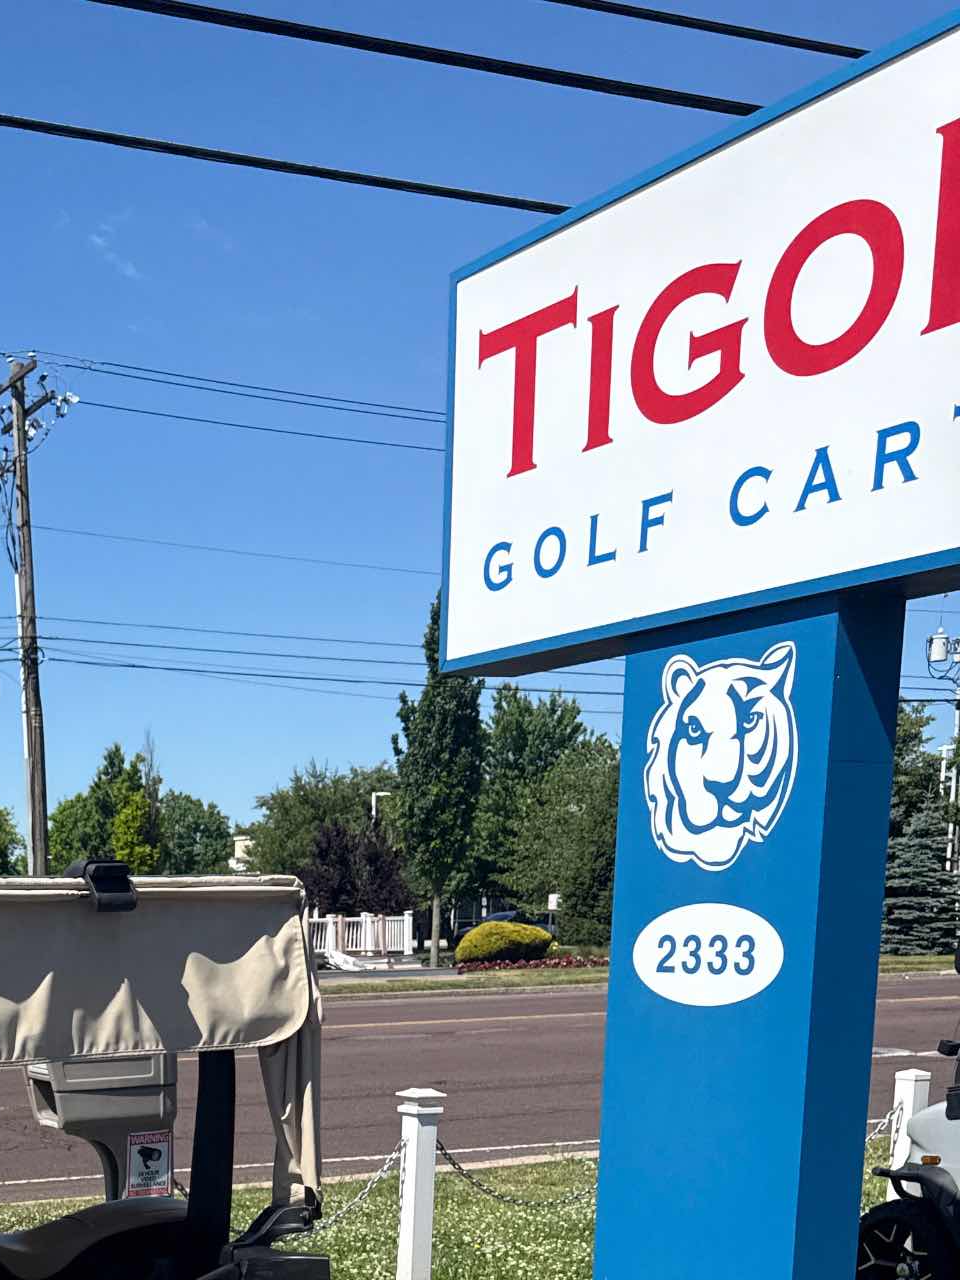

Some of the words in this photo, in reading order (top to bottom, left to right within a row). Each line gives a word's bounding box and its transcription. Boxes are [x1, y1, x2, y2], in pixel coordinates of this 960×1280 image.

[483, 489, 674, 592] GOLF
[728, 403, 960, 527] CAR
[655, 933, 757, 977] 2333
[131, 1134, 168, 1146] WARNING
